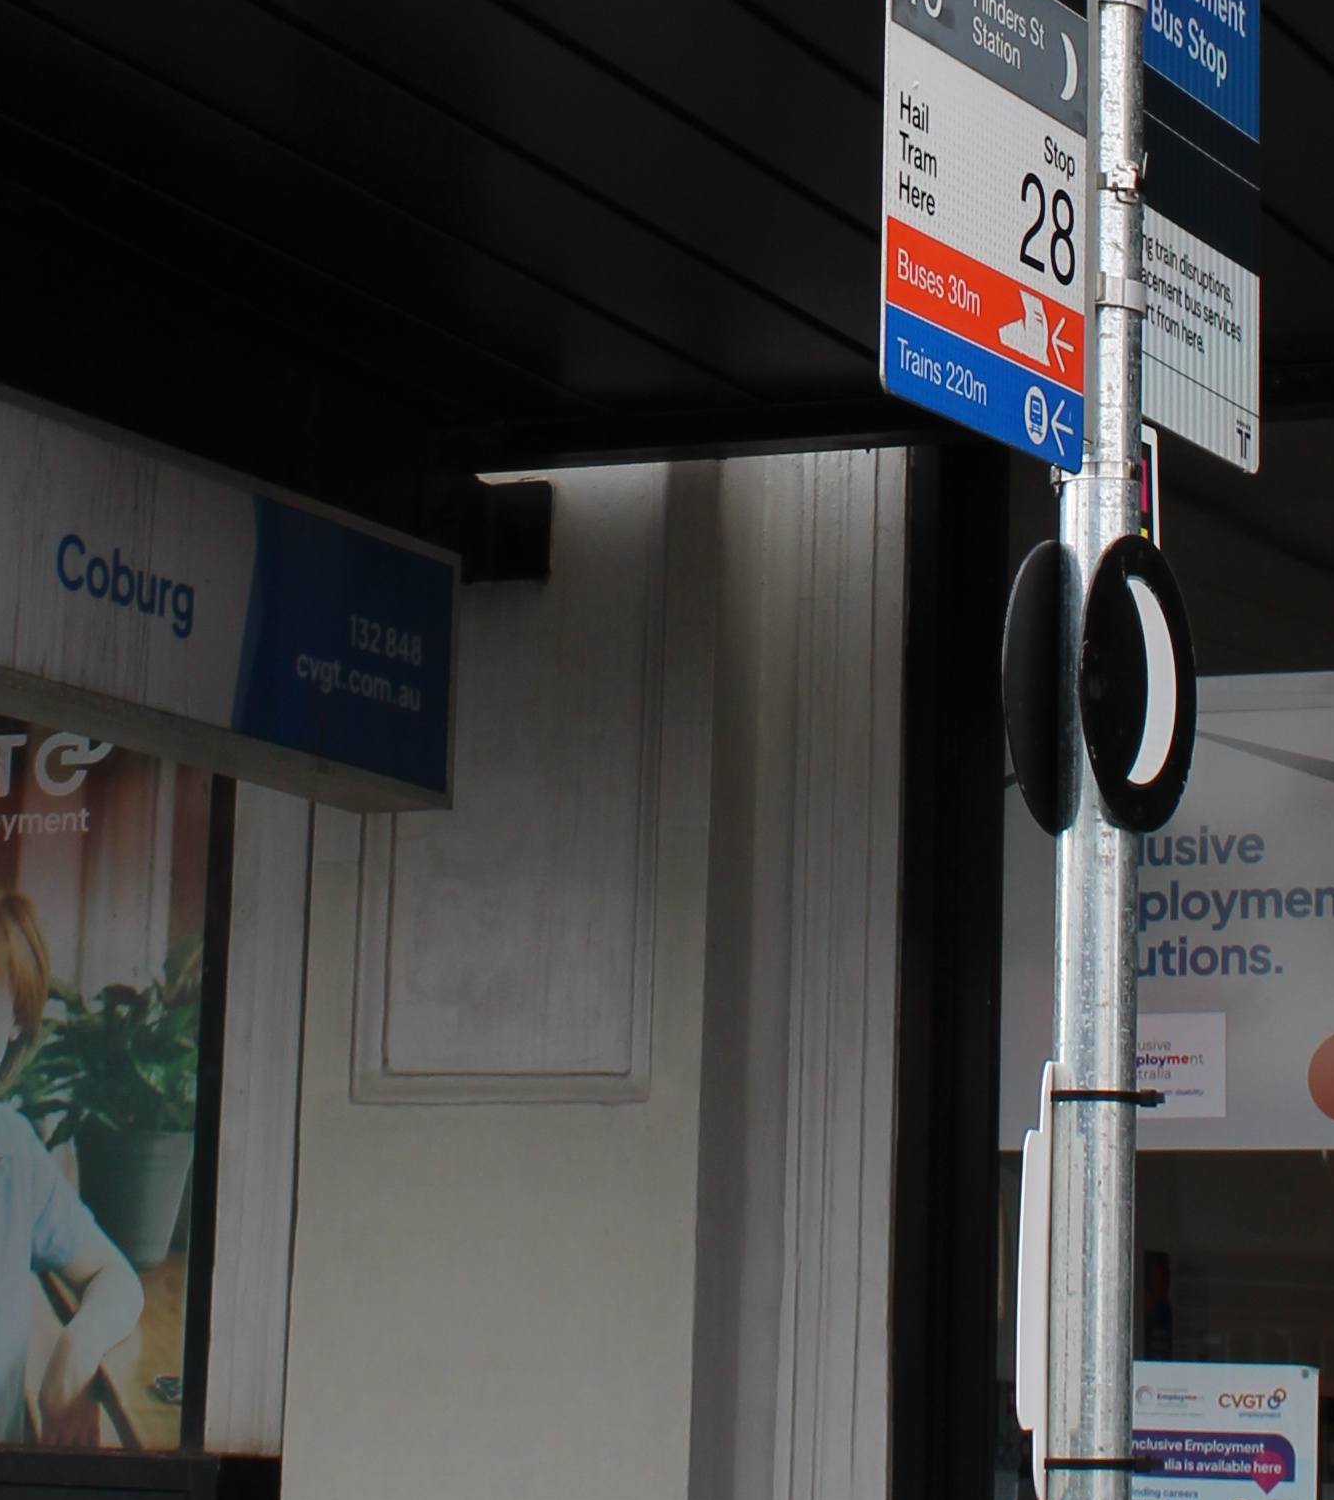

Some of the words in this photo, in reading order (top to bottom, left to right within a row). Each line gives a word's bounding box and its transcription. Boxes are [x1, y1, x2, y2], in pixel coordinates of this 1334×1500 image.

[972, 17, 1022, 70] Station
[1030, 11, 1045, 50] St
[1189, 26, 1228, 87] Stop
[899, 90, 930, 134] Hail
[898, 133, 938, 179] Tram
[1044, 135, 1076, 182] Stop
[898, 171, 936, 216] Here
[1019, 171, 1076, 287] 28
[897, 247, 945, 306] Buses
[947, 270, 982, 318] 30m
[1156, 238, 1178, 272] train
[1179, 254, 1234, 310] disruptions,
[1141, 270, 1183, 308] acement
[1184, 290, 1202, 319] bus
[1203, 305, 1242, 343] services
[1157, 308, 1180, 340] from
[1182, 320, 1205, 354] here.
[897, 336, 942, 385] Trains
[945, 361, 988, 407] 220m
[56, 533, 195, 639] Coburg
[350, 614, 381, 654] 132
[385, 627, 422, 667] 848
[295, 653, 421, 712] cvgt.com.au
[1136, 825, 1265, 868] lusive
[1136, 936, 1284, 979] utions.
[1136, 1053, 1204, 1068] ployment
[1218, 1392, 1265, 1409] CVGT
[1131, 1437, 1183, 1452] nclusive
[1184, 1438, 1265, 1455] Employment
[1184, 1458, 1194, 1471] is
[1196, 1458, 1252, 1473] available
[1253, 1460, 1282, 1475] here
